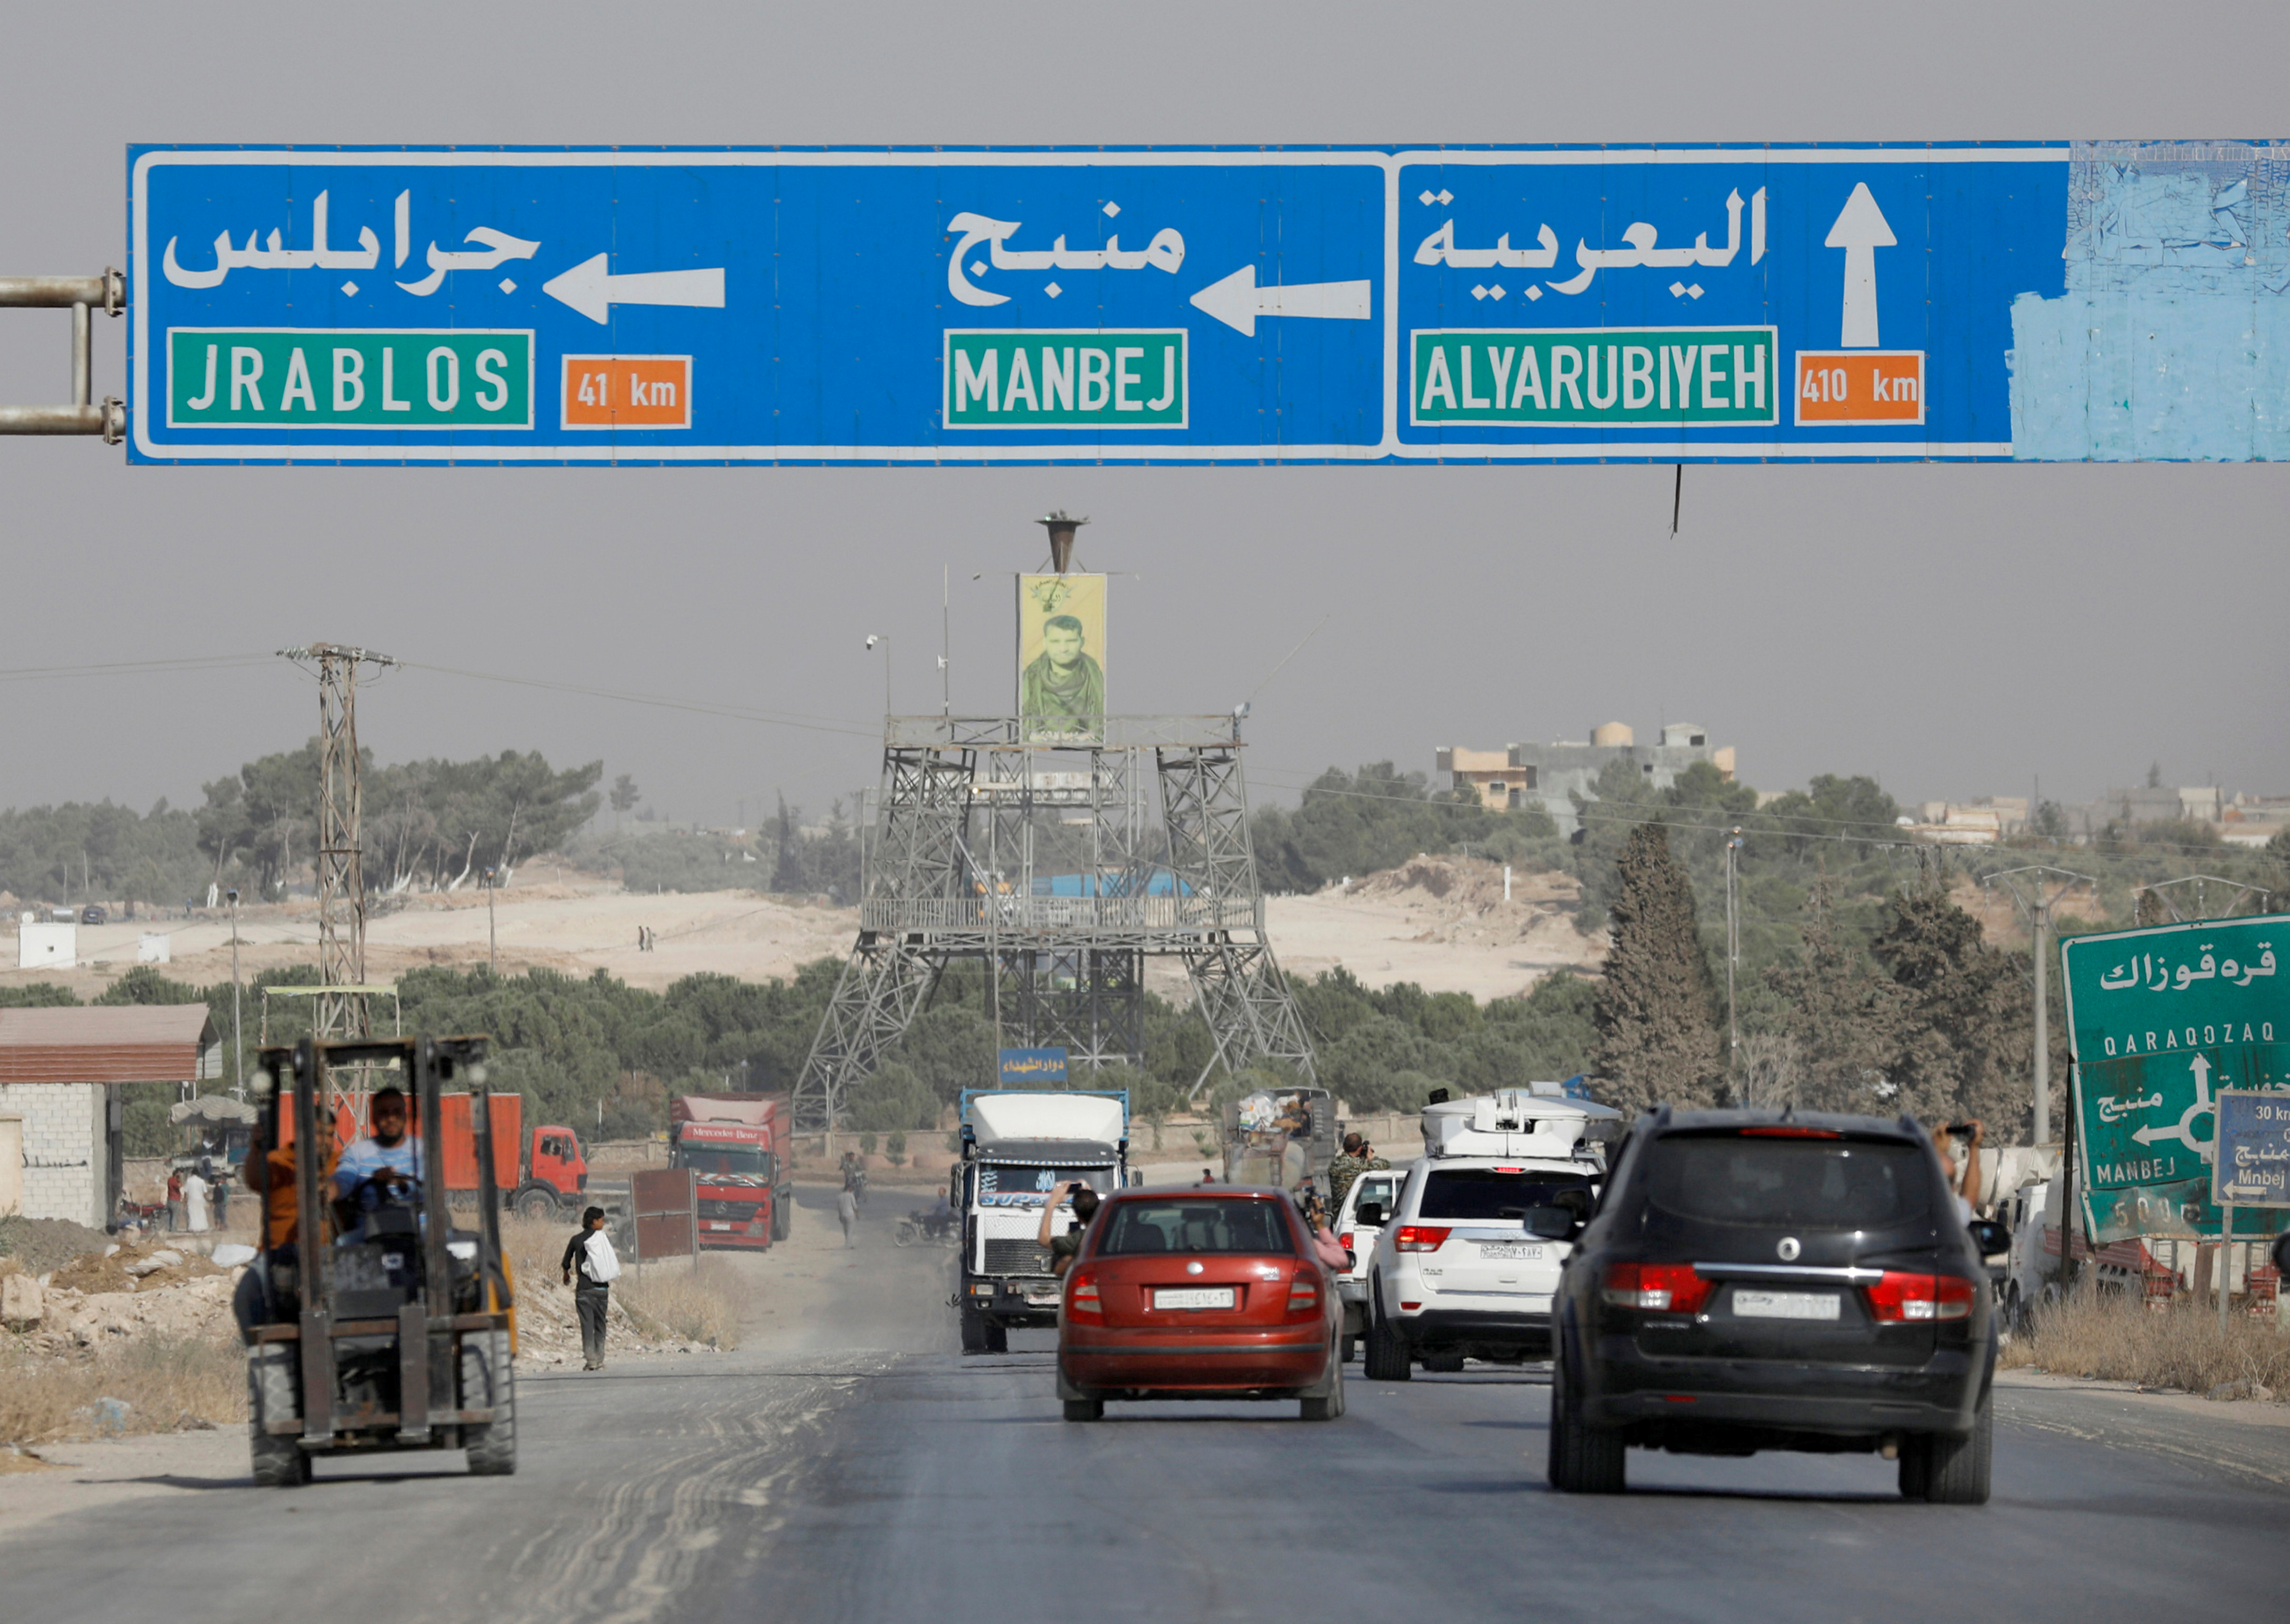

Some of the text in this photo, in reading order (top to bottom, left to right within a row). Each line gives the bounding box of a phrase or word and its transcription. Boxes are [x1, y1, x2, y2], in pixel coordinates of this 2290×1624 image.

[163, 188, 541, 297] جرابلس
[947, 200, 1186, 307] منبج
[1413, 186, 1766, 301] اليعربية
[187, 344, 508, 412] JRABLOS
[577, 372, 676, 407] 41 km
[955, 346, 1175, 412] MANBEJ
[1420, 344, 1765, 410] ALYARUBIYEH
[1802, 368, 1917, 403] 410 km
[2100, 941, 2276, 992] قره قوزاك
[2104, 1022, 2274, 1056] QARAQOZAQ
[2097, 1086, 2163, 1123] منبج
[2255, 1105, 2272, 1120] 30
[692, 1128, 758, 1139] Mercedes Benz
[2096, 1156, 2175, 1184] MANBEJ
[2235, 1143, 2289, 1167] منبج
[2238, 1169, 2285, 1189] Mnbej
